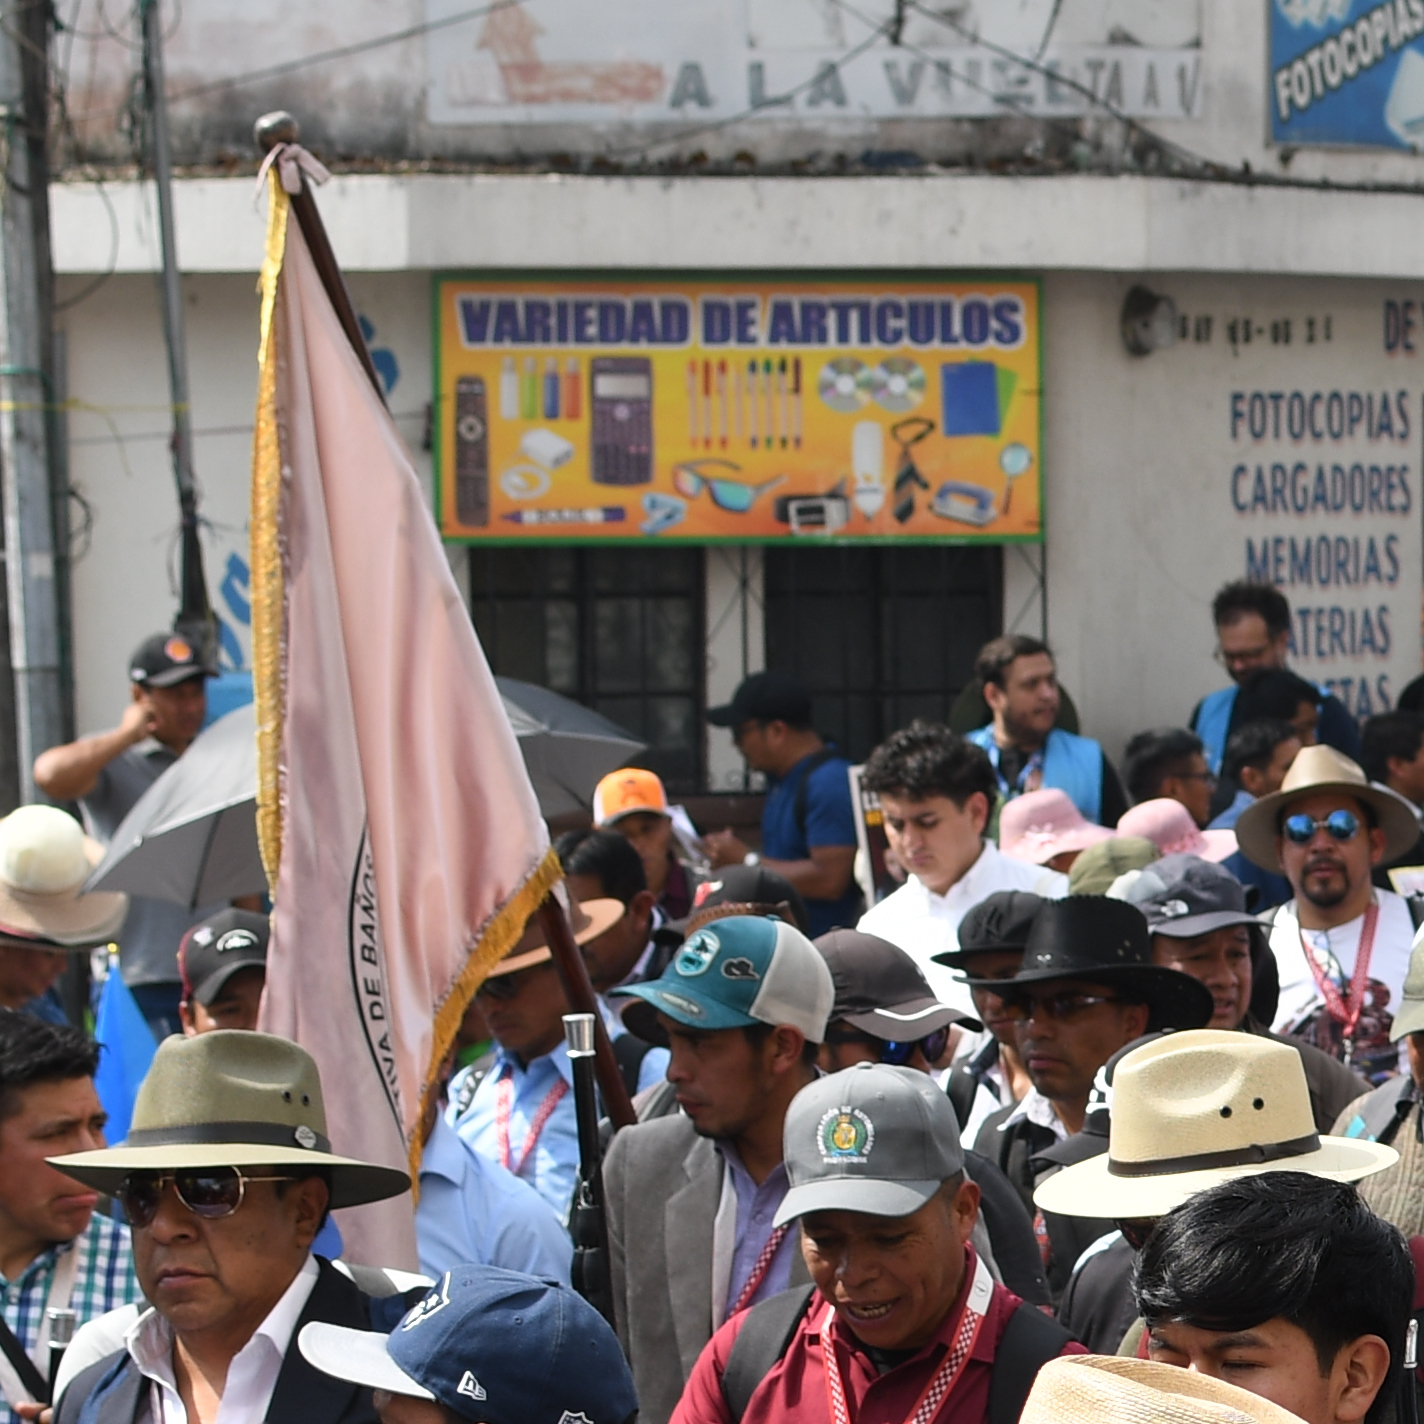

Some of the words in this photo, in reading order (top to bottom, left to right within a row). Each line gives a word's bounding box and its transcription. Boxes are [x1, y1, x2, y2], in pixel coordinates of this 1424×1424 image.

[458, 293, 691, 348] VARIEDAD
[702, 294, 760, 347] DE
[767, 293, 1026, 348] ARTICULOS
[1384, 301, 1414, 353] DE
[1230, 390, 1410, 441] FOTOCOPIAS
[1231, 462, 1412, 514] CARGADORES
[1245, 533, 1400, 587] MEMORIAS
[1288, 604, 1390, 660] ATERIAS
[363, 976, 385, 1021] DE
